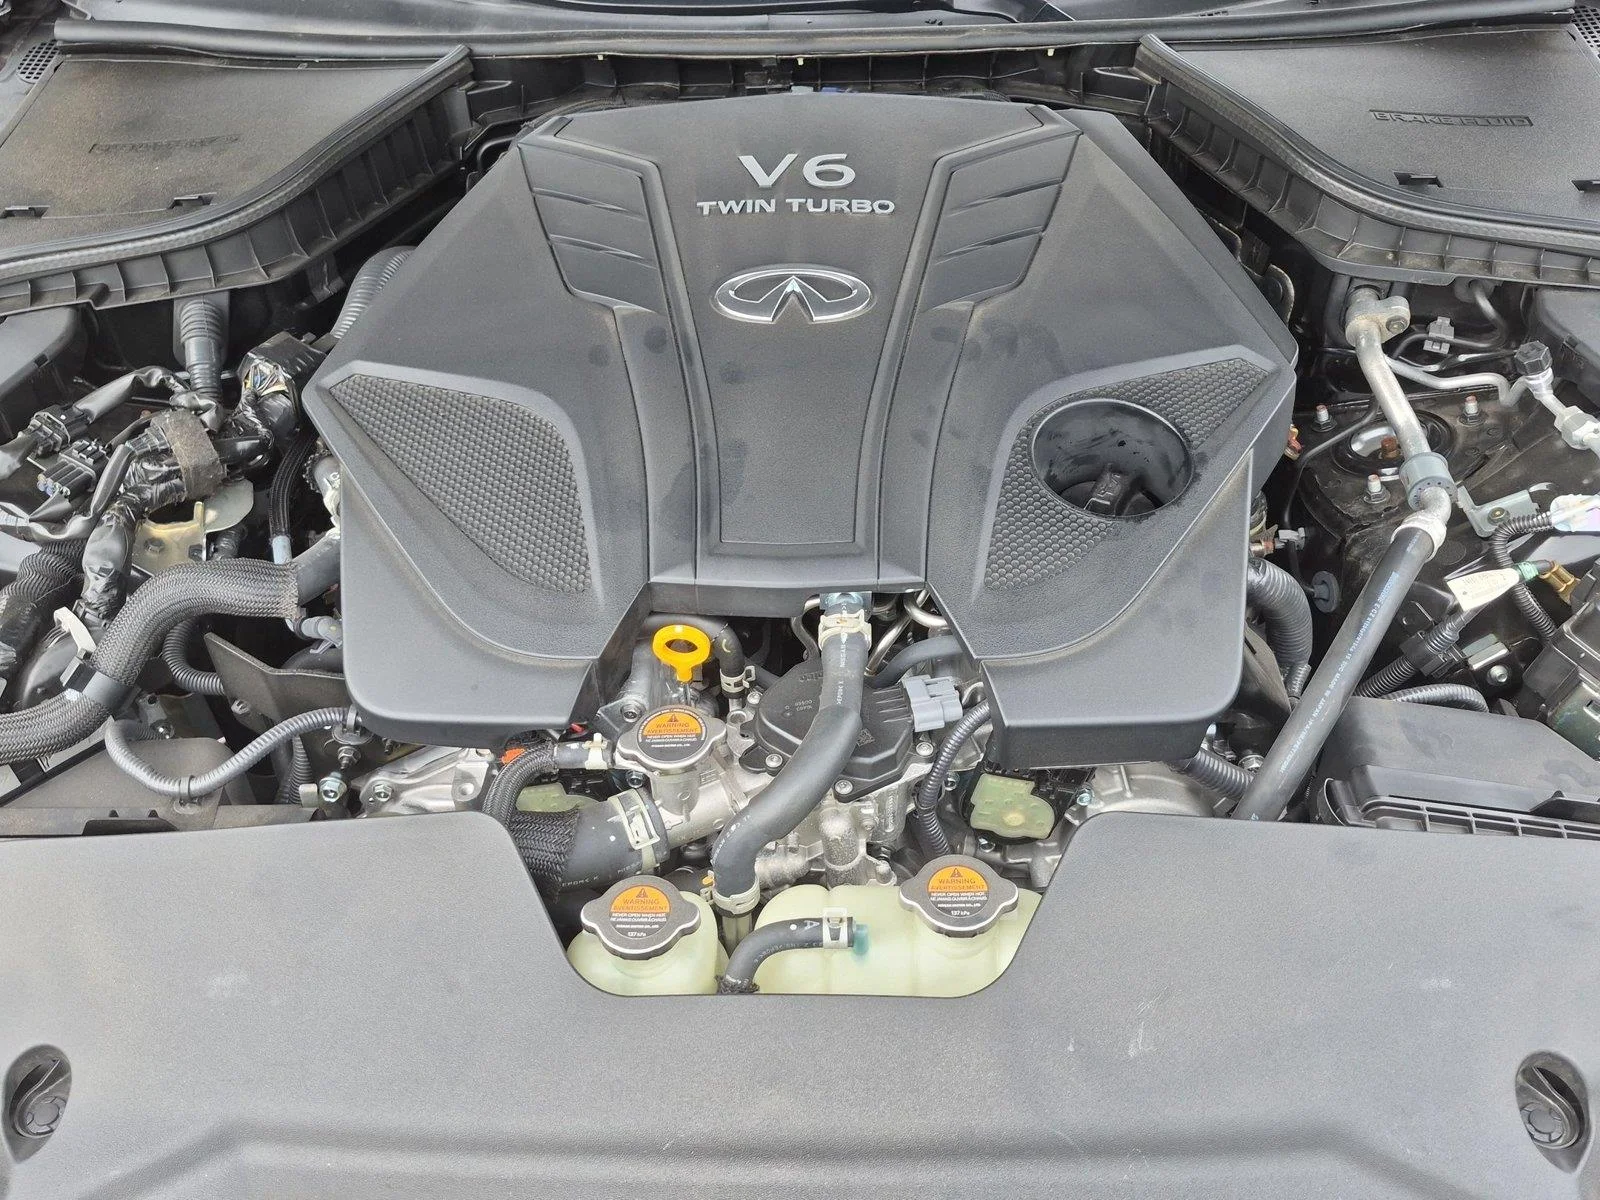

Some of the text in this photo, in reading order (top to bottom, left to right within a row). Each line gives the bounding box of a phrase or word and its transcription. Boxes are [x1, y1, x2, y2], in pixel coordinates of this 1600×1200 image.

[1373, 111, 1532, 126] BRAKE FLUID
[737, 153, 856, 188] V6
[696, 199, 895, 216] TWIN TURBO
